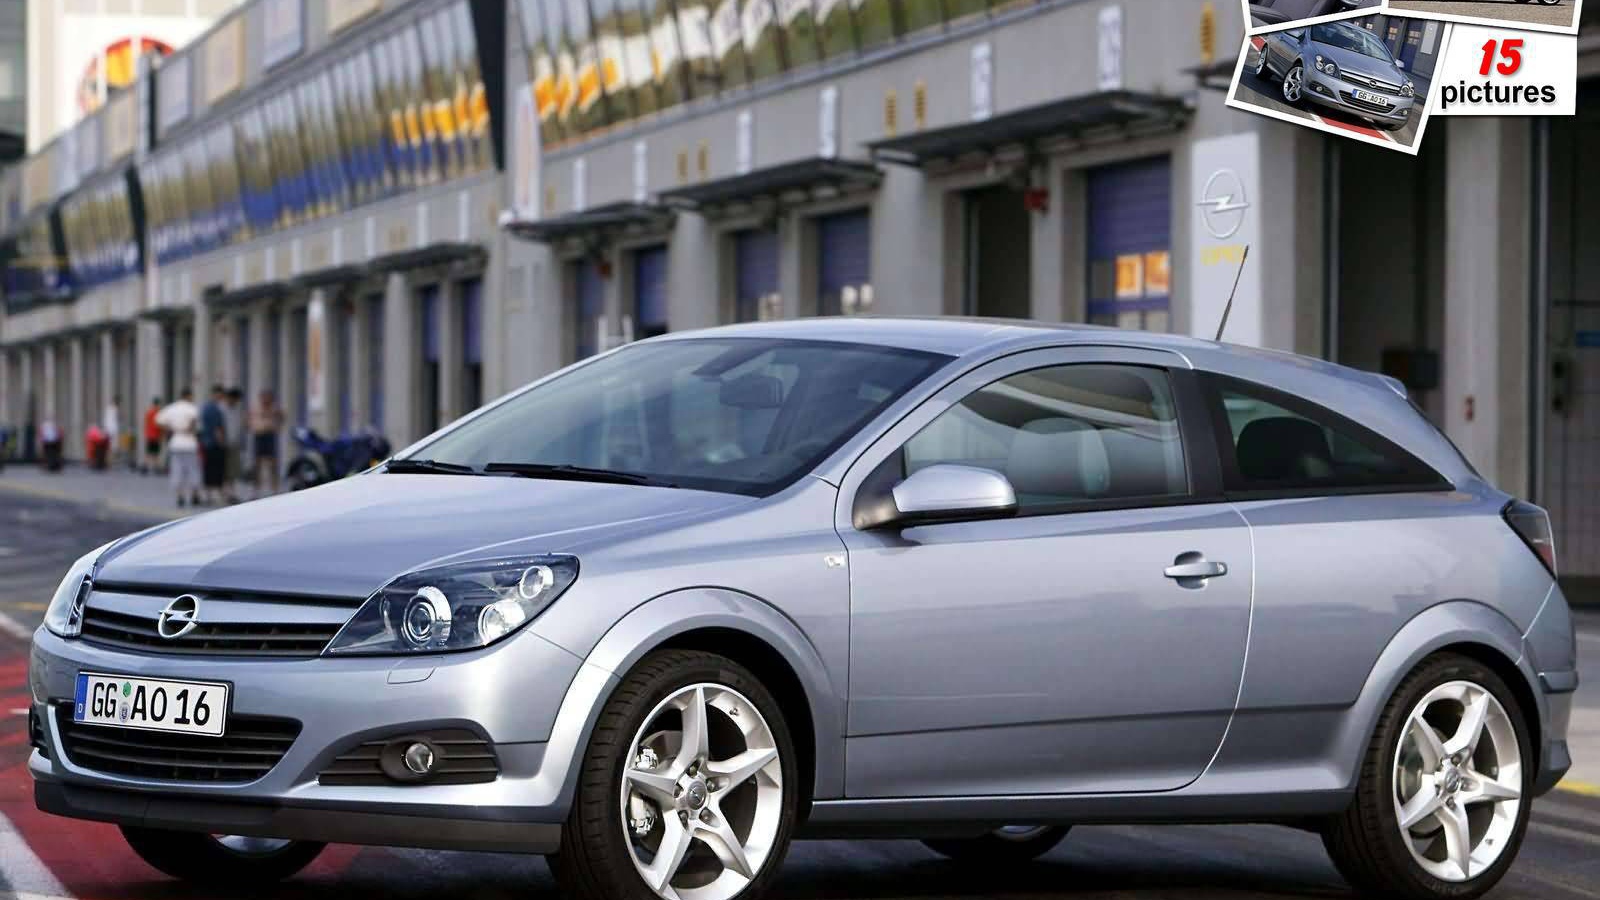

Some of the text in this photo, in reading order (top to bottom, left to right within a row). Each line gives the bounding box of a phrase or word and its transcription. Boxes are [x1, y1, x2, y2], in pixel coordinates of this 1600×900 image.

[78, 703, 83, 713] D
[92, 682, 210, 726] GG AO 16
